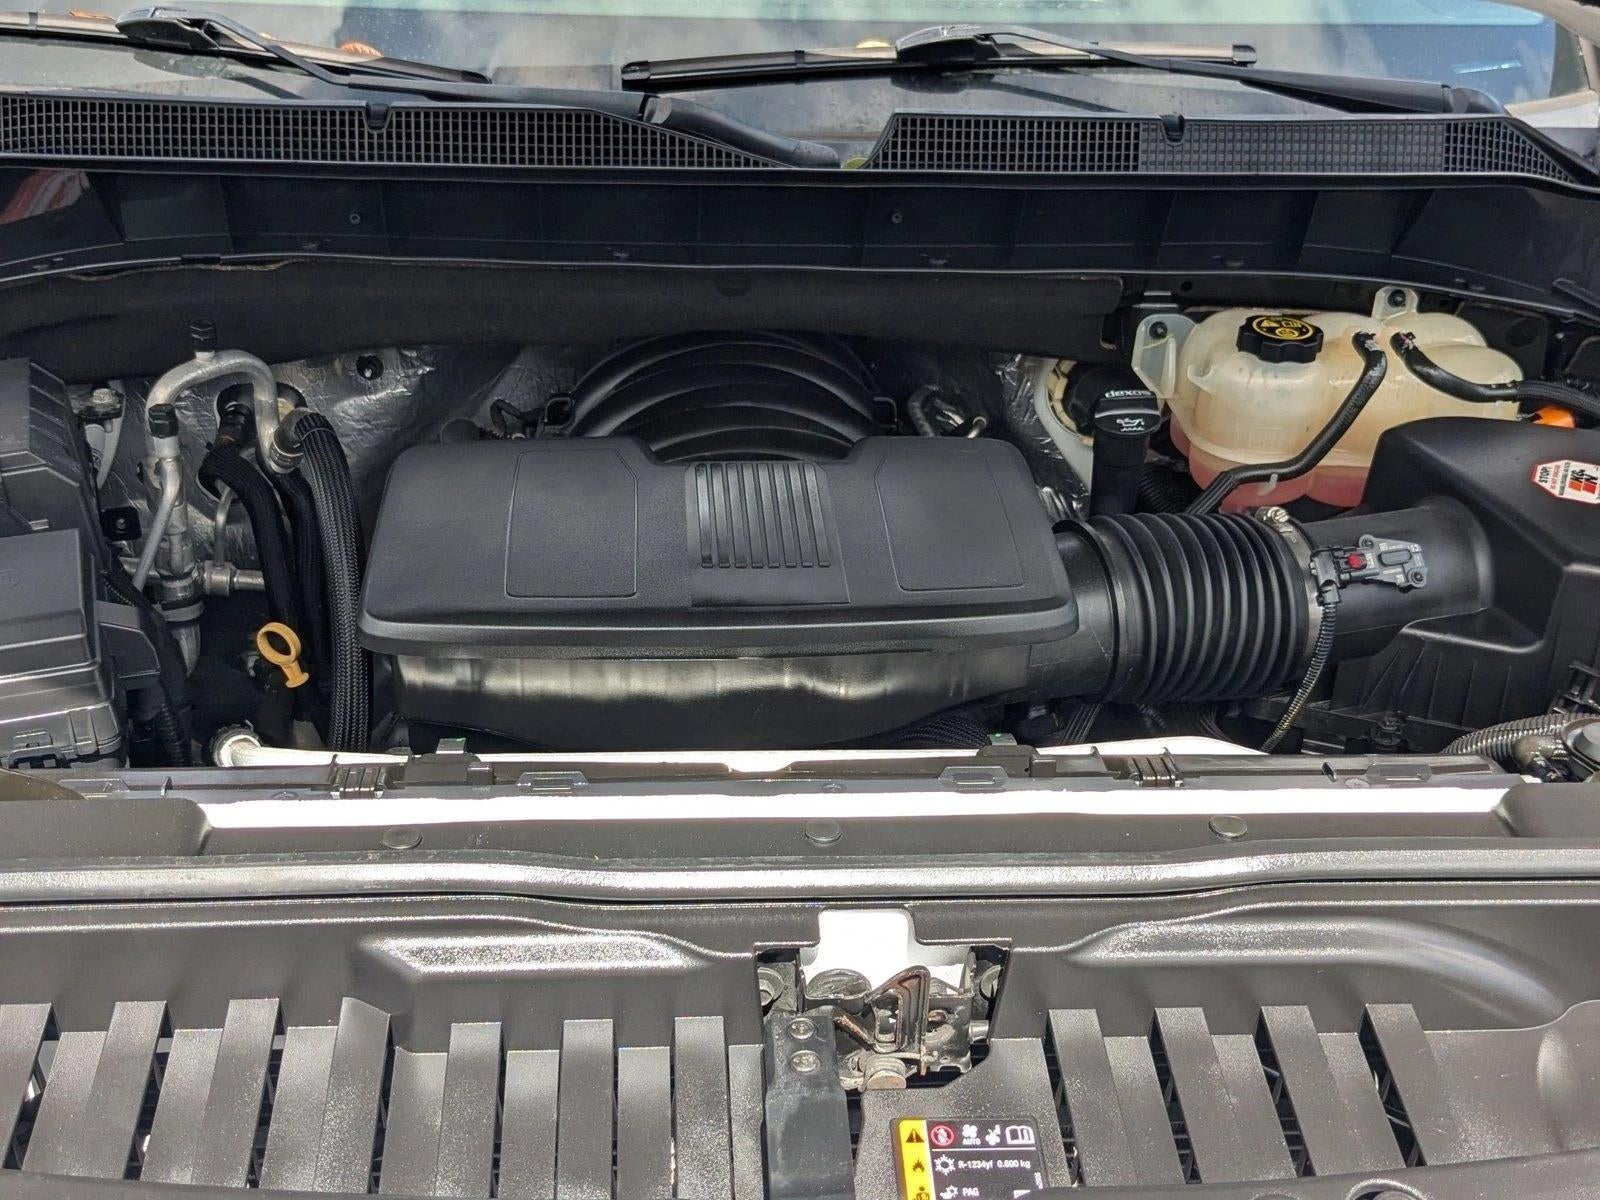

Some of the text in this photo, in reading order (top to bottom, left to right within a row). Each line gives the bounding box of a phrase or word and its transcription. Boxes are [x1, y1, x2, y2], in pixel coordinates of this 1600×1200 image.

[1105, 390, 1151, 398] dexos
[962, 1138, 981, 1146] AUTO
[958, 1160, 993, 1170] R-1234yf
[1020, 1160, 1031, 1169] kg
[962, 1187, 979, 1196] PAG
